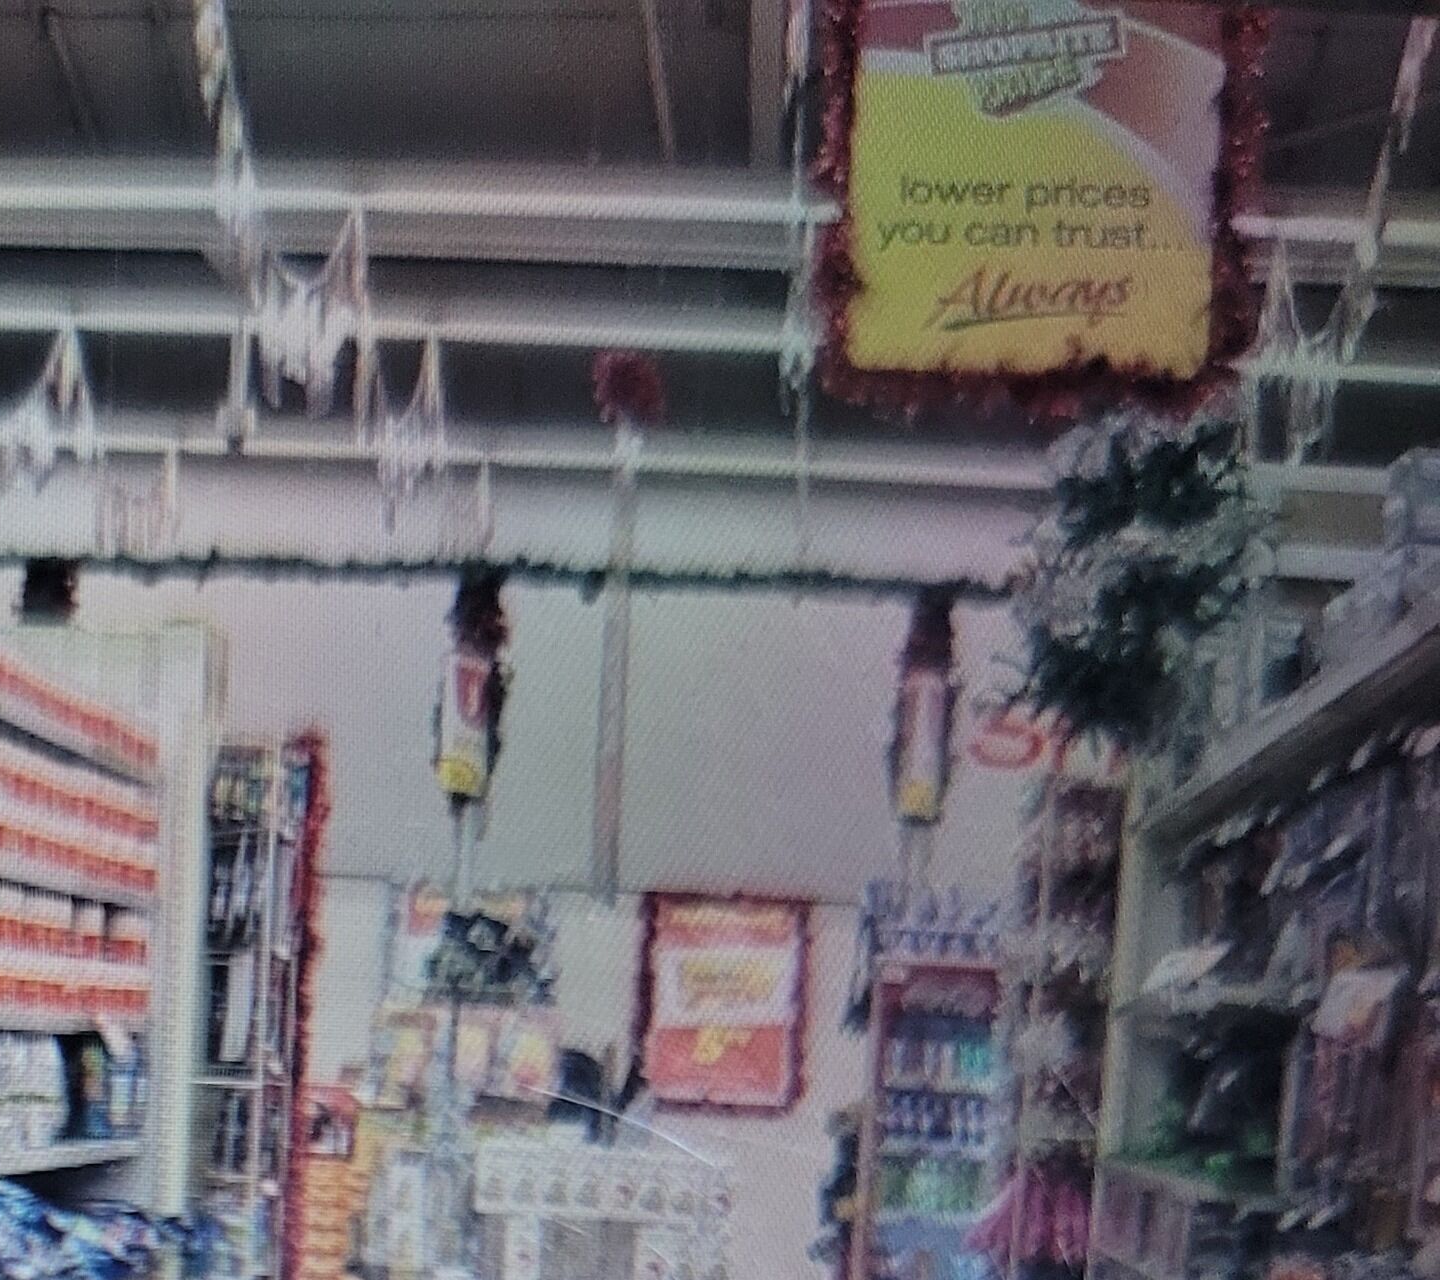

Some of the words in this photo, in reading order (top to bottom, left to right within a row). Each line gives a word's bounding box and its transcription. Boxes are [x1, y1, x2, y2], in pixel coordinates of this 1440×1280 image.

[899, 177, 1010, 209] lower
[1024, 177, 1151, 218] prices
[876, 219, 950, 251] you
[964, 219, 1038, 248] can
[934, 264, 1133, 327] Always
